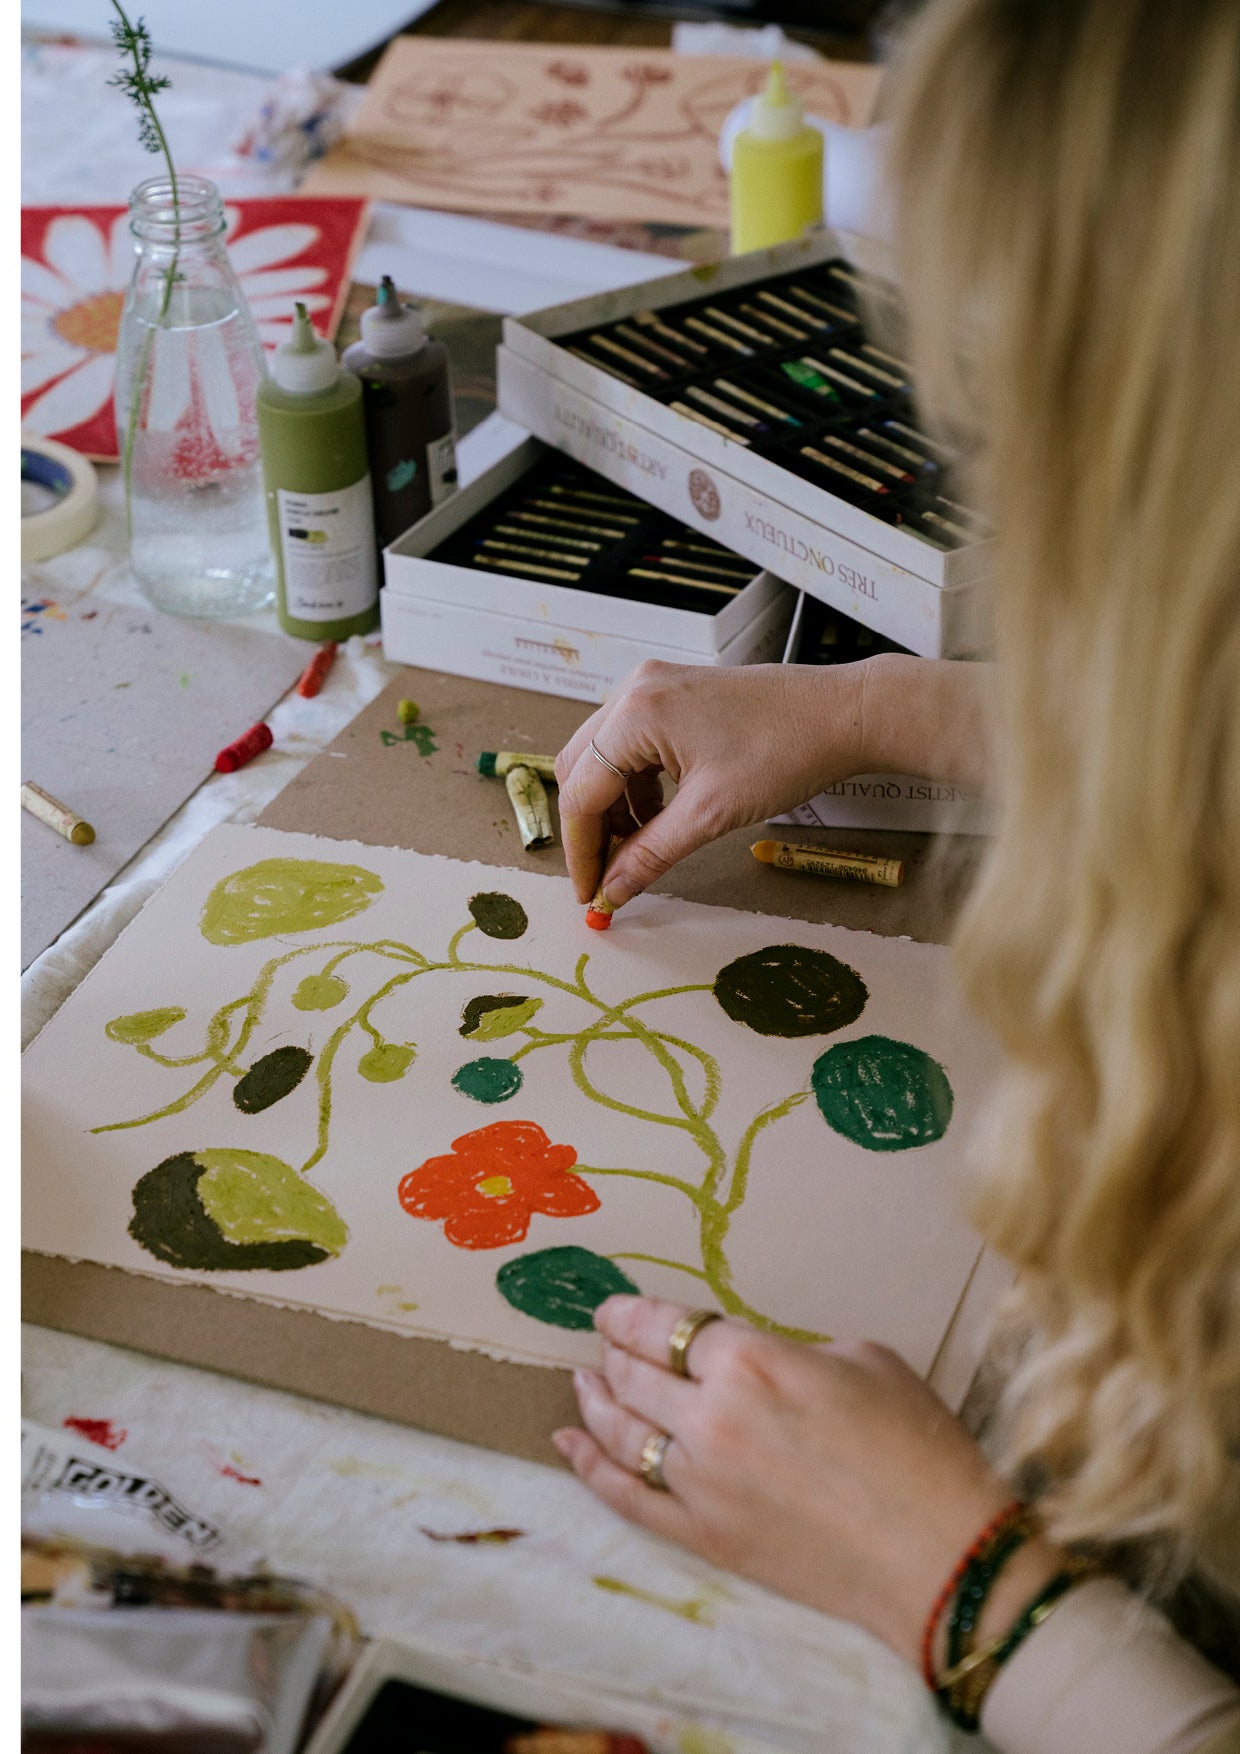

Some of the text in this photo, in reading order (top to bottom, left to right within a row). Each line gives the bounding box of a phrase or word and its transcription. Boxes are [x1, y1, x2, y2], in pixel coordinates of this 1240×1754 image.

[744, 510, 835, 576] ONCTUEUX
[904, 785, 969, 802] ARTIST
[59, 1459, 220, 1549] GOLDEN
